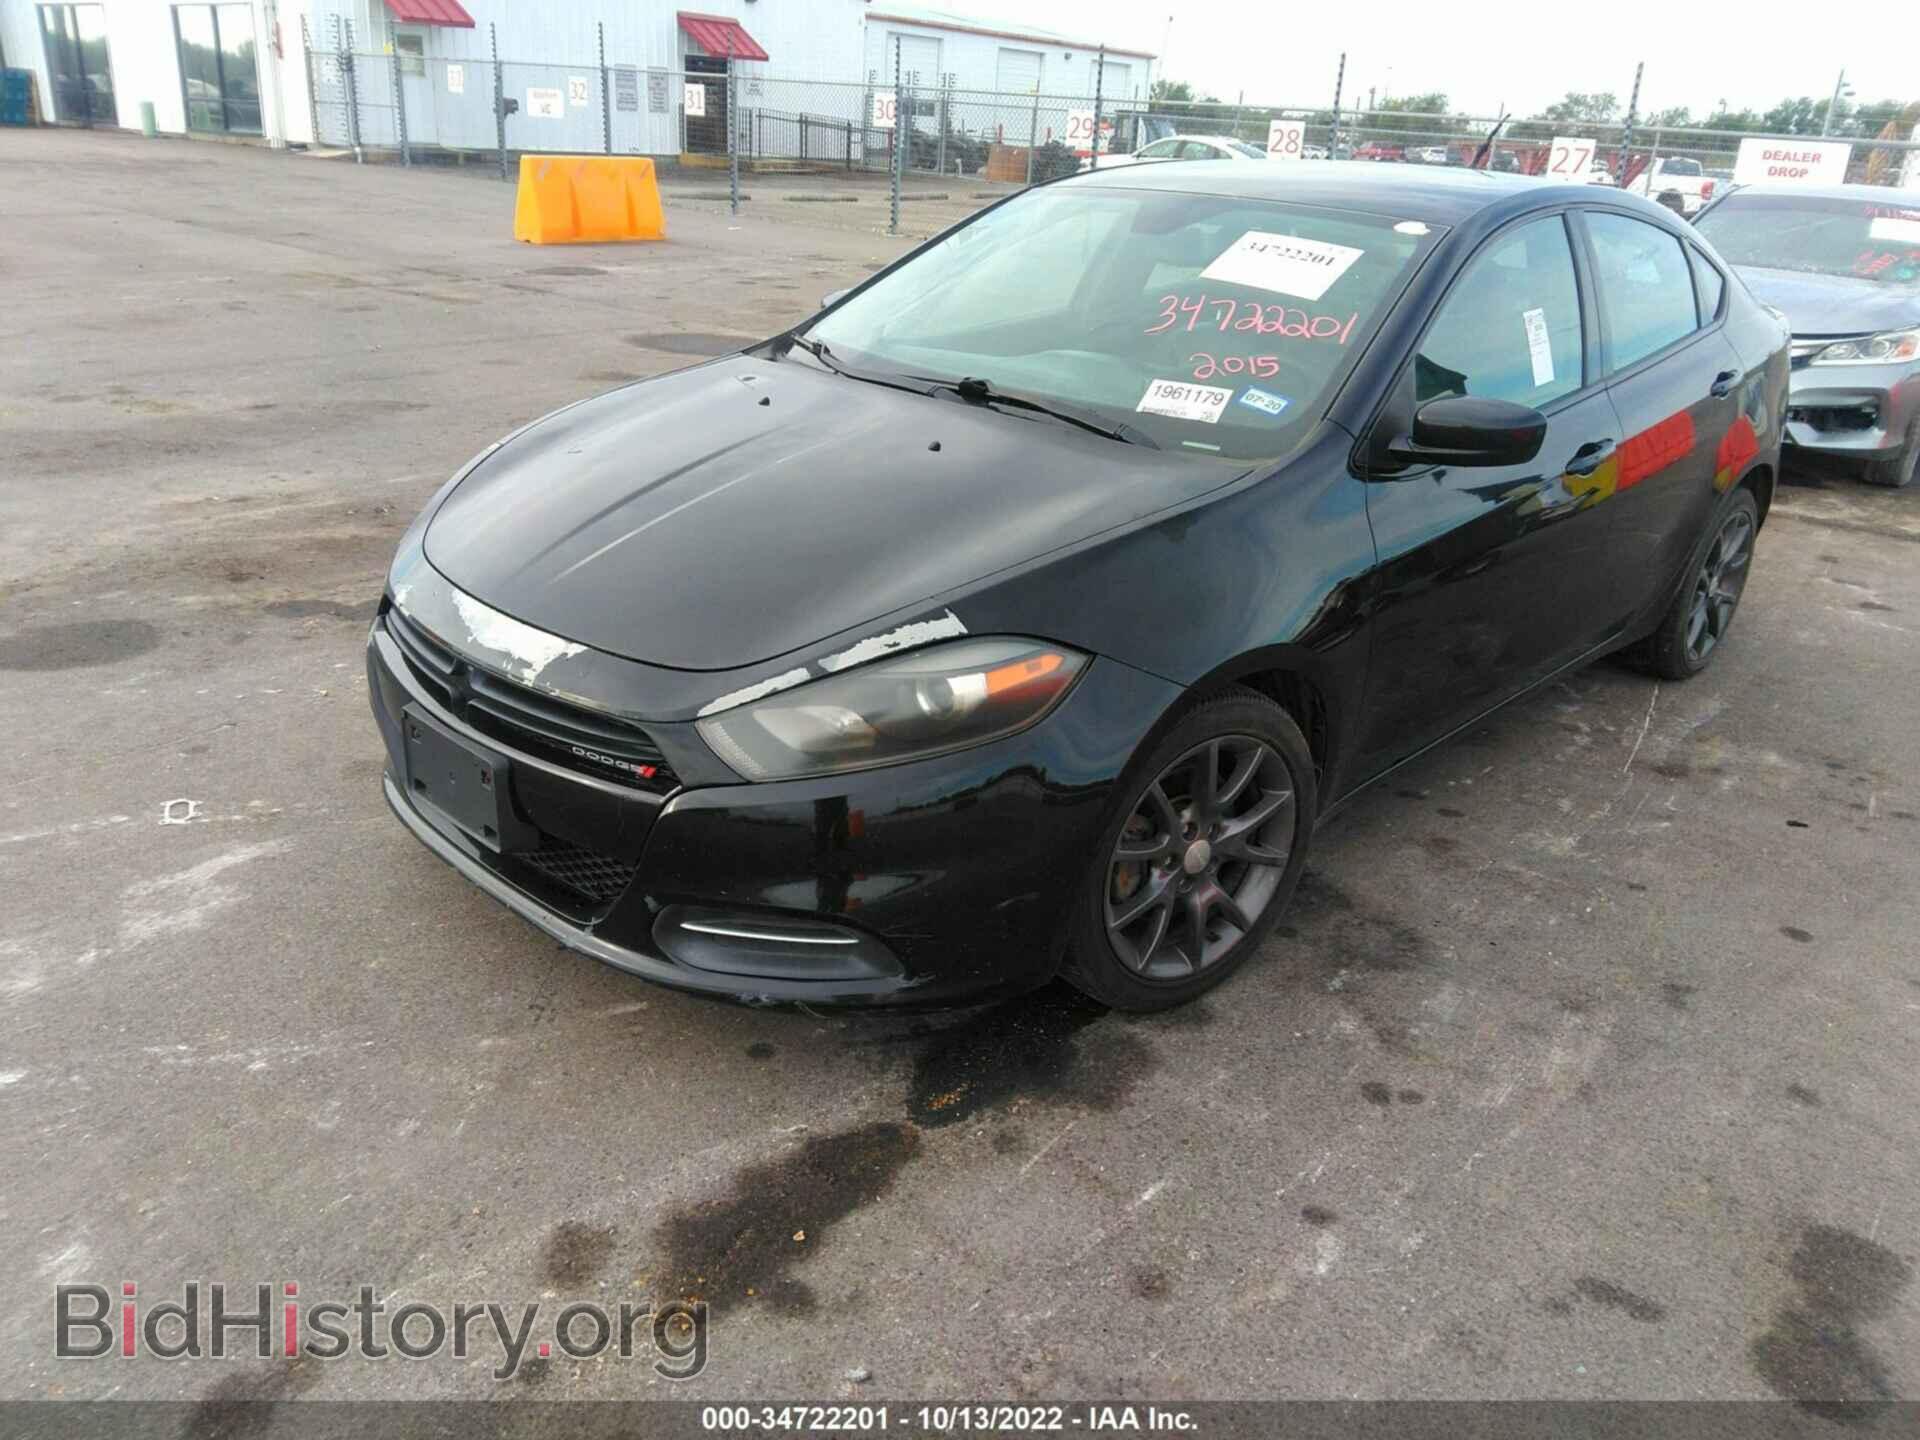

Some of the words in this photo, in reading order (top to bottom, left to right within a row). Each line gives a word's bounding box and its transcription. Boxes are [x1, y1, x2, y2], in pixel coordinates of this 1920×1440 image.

[570, 80, 586, 101] 32
[686, 90, 703, 109] 31
[876, 99, 896, 120] 30
[1068, 116, 1093, 140] 29
[1270, 128, 1300, 154] 28
[1551, 147, 1591, 174] 27
[1762, 149, 1822, 163] DEALER
[1767, 165, 1809, 178] DROP
[1144, 294, 1358, 345] 34722201
[1189, 353, 1280, 380] 2015
[1153, 384, 1225, 406] 1961179
[572, 745, 644, 775] DODGE
